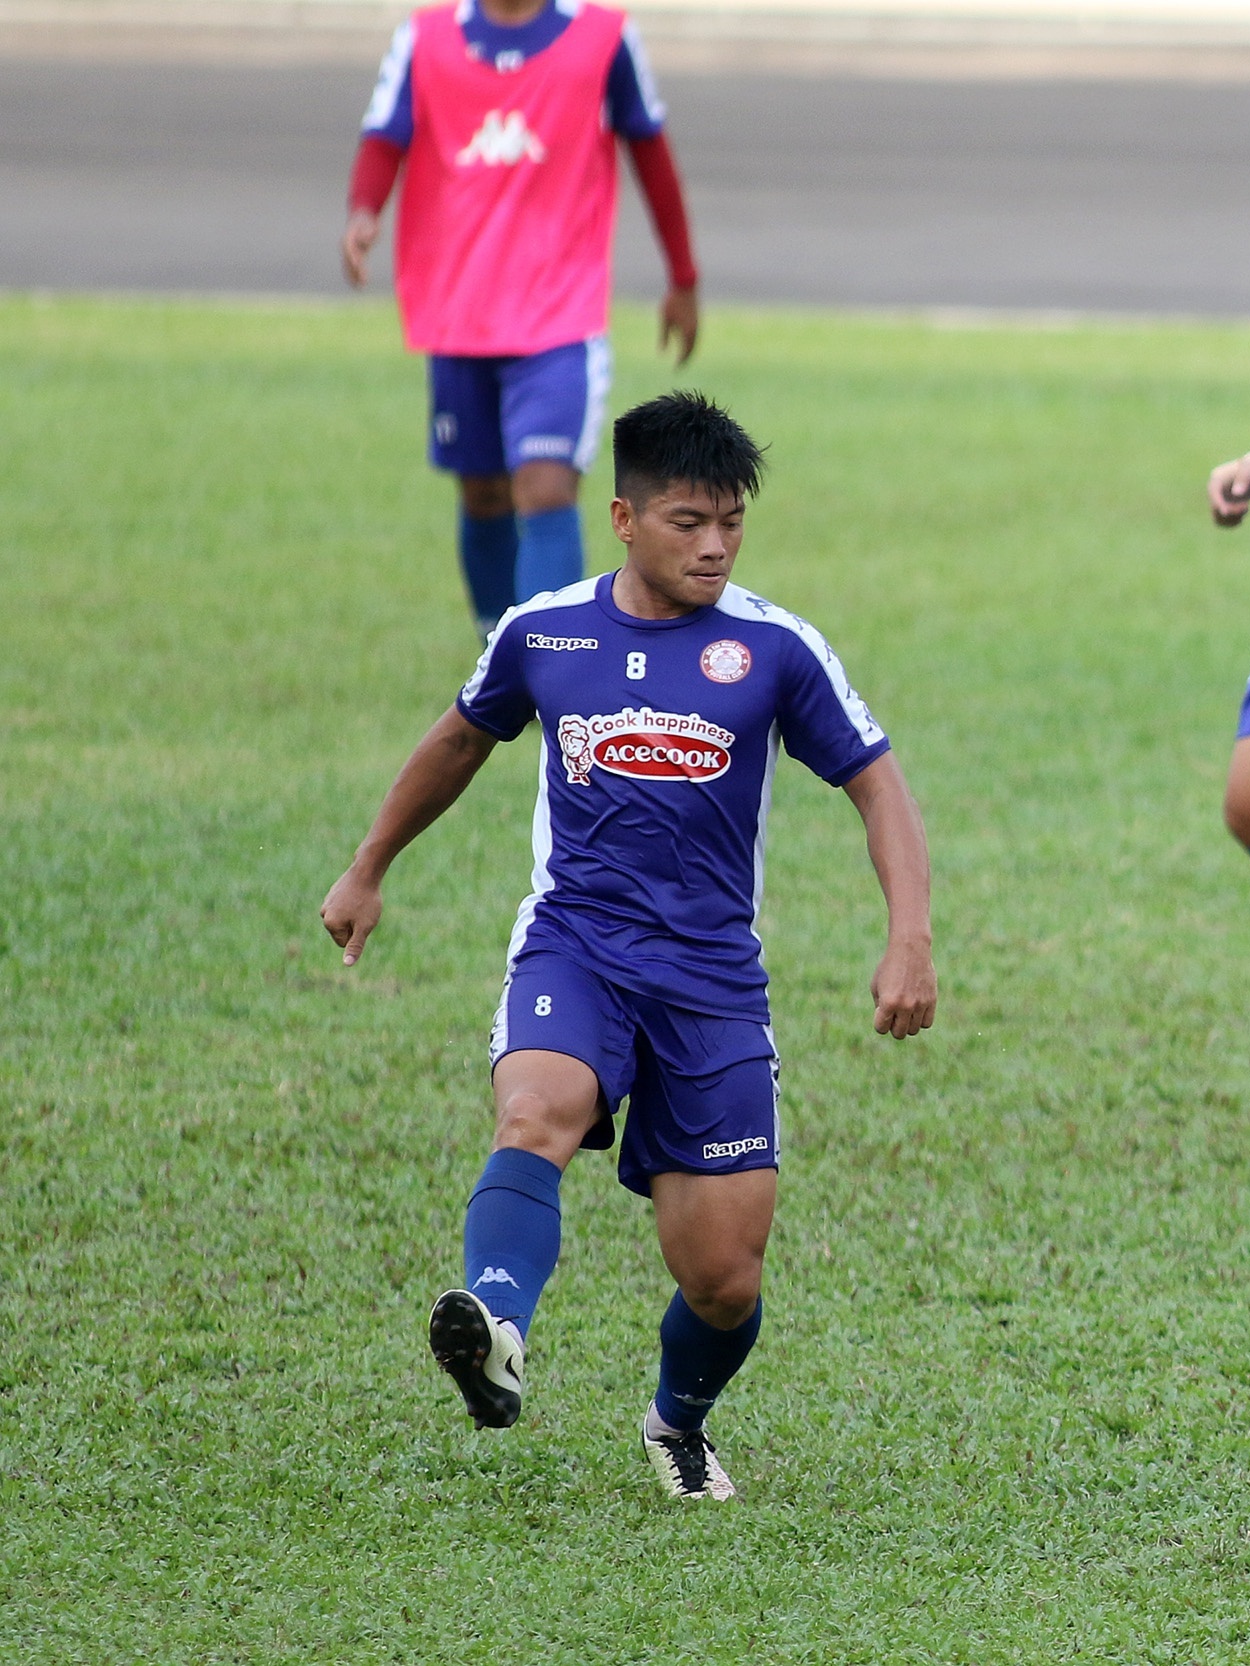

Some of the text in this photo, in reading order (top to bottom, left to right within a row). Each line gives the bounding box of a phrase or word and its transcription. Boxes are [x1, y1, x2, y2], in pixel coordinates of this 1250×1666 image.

[526, 634, 598, 651] Kappa
[626, 651, 646, 680] 8
[591, 712, 734, 744] Cook happiness
[534, 995, 552, 1016] 8
[703, 1137, 768, 1159] Kappa
